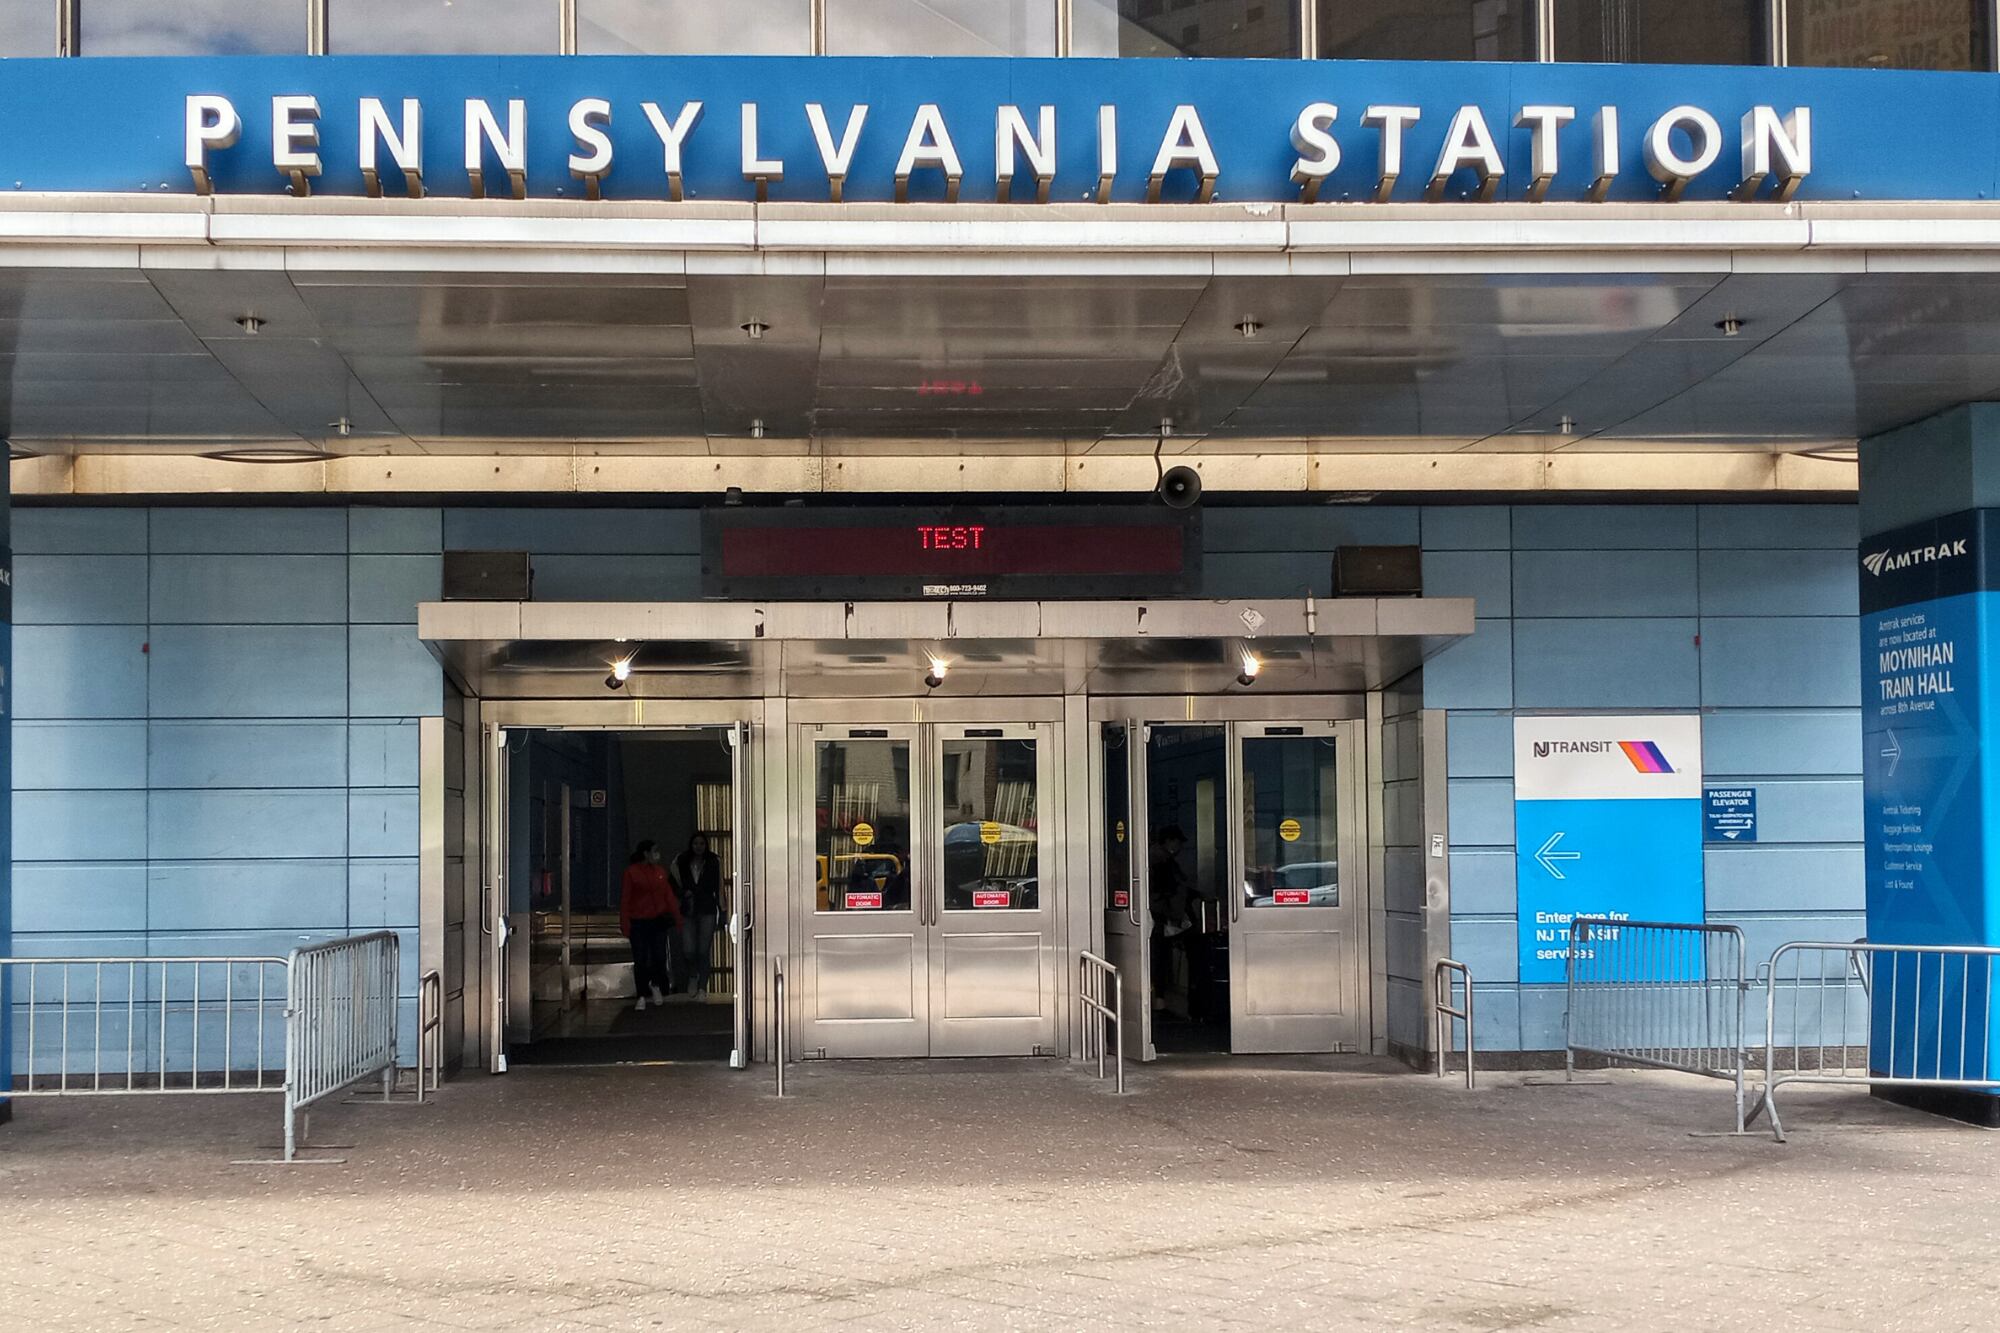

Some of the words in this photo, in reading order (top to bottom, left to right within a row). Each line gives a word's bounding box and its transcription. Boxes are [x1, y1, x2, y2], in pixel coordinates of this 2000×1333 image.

[184, 94, 1220, 181] PENNSYLVANIA
[1288, 101, 1812, 183] STATION
[917, 526, 985, 549] TEST
[1884, 538, 1967, 572] AMTRAK
[1879, 617, 1900, 632] Amtrak
[1900, 613, 1926, 628] services
[1879, 637, 1888, 647] are
[1889, 635, 1902, 645] now
[1903, 626, 1928, 643] located
[1928, 627, 1937, 638] at
[1879, 641, 1954, 674] MOYNIHAN
[1879, 675, 1914, 701] TRAIN
[1917, 670, 1955, 695] HALL
[1897, 701, 1909, 713] 8th
[1909, 700, 1936, 712] Avenue
[1551, 741, 1613, 753] TRANSIT
[1709, 790, 1753, 798] PASSENGER
[1913, 843, 1933, 854] Lounge
[1898, 879, 1914, 889] Found
[1536, 911, 1573, 924] Enter
[1609, 911, 1629, 922] for
[1536, 930, 1555, 942] NJ
[1558, 929, 1620, 942] TNSIT
